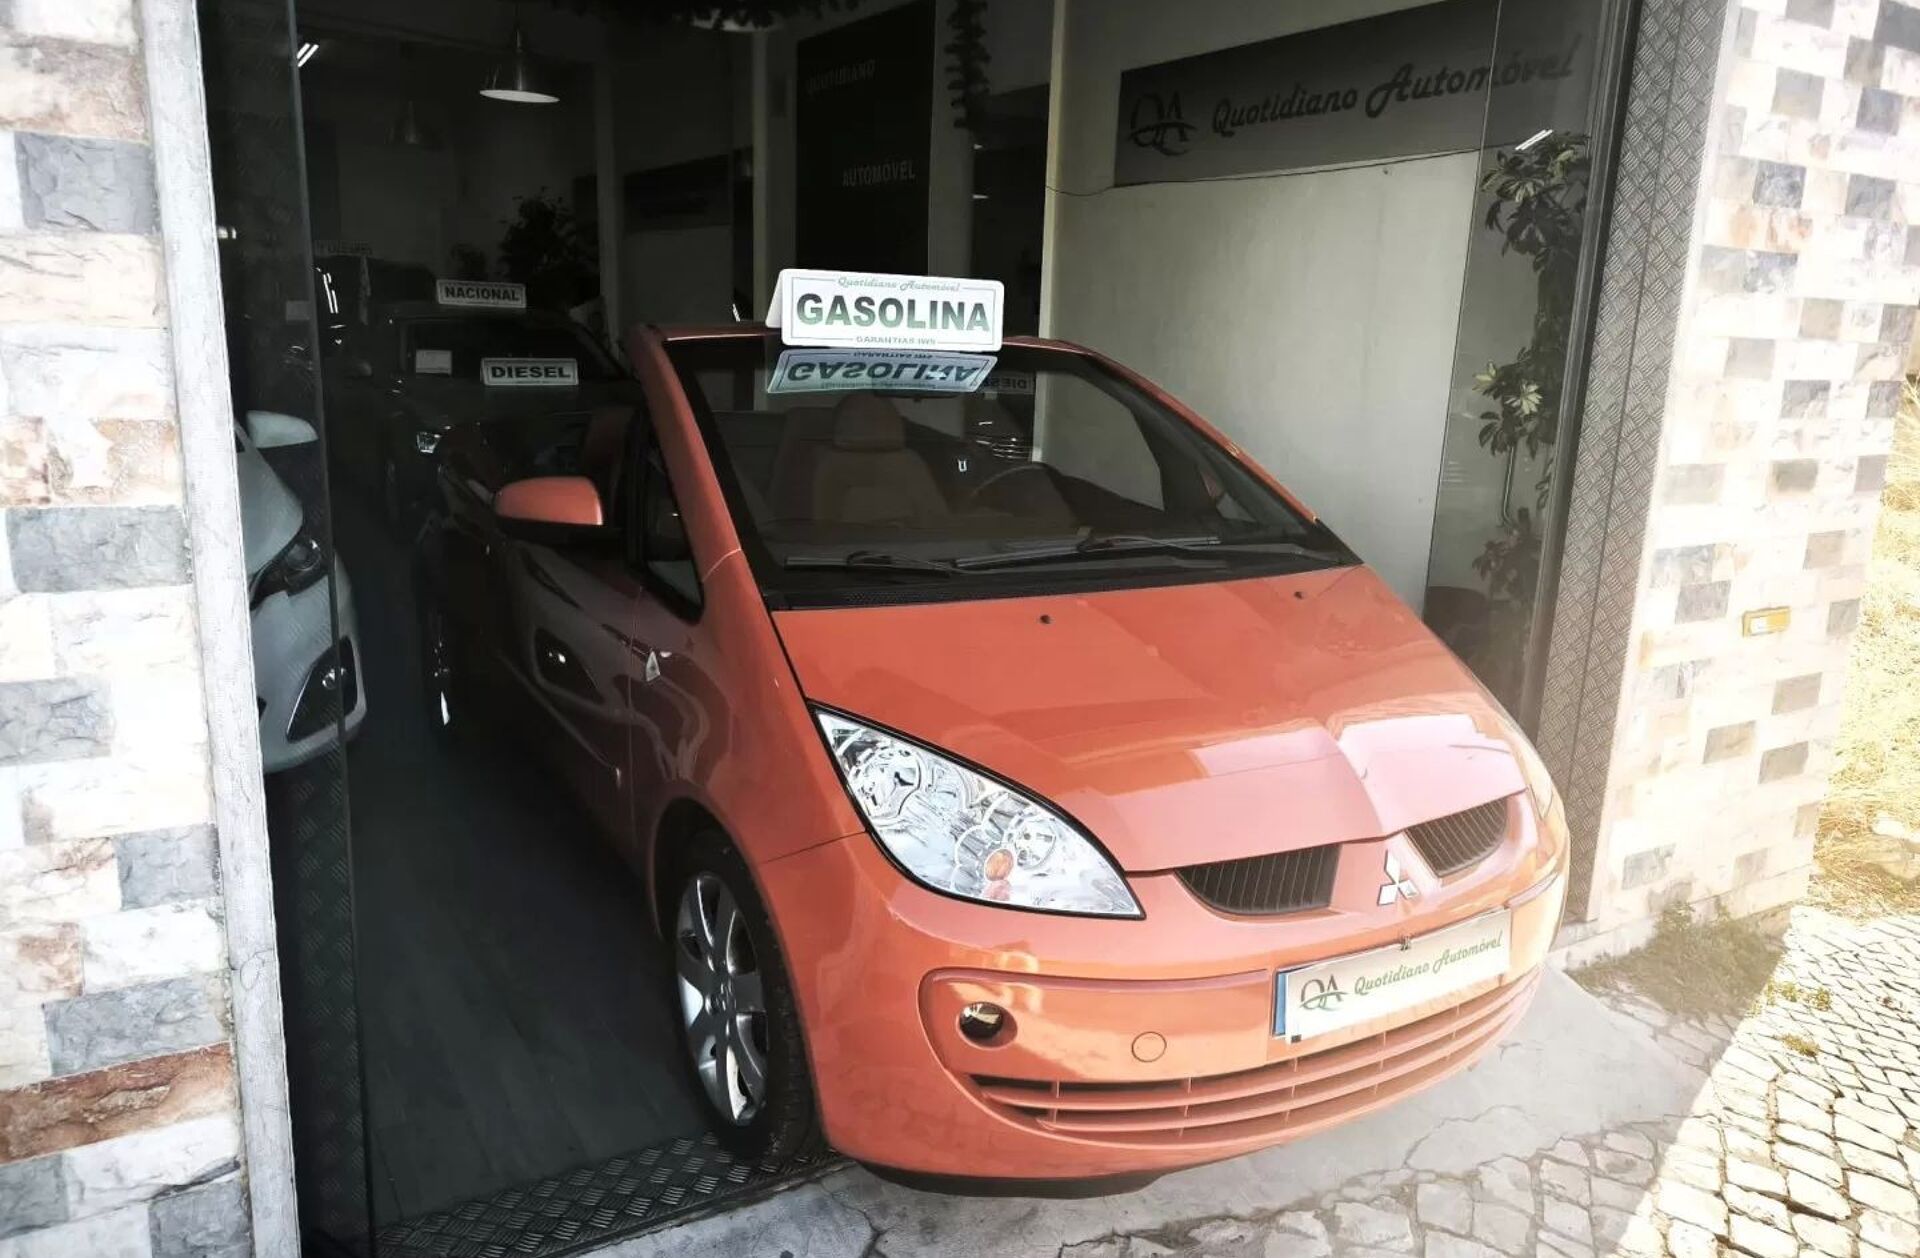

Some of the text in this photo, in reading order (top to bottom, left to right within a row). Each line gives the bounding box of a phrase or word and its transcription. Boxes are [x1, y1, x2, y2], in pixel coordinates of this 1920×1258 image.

[1212, 34, 1582, 138] Quotidiano Automóvel
[445, 286, 520, 301] NACIONAL
[796, 293, 990, 332] GASOLINA
[491, 366, 571, 379] DIESEL
[1354, 930, 1503, 996] Quotidiano Automóvel
